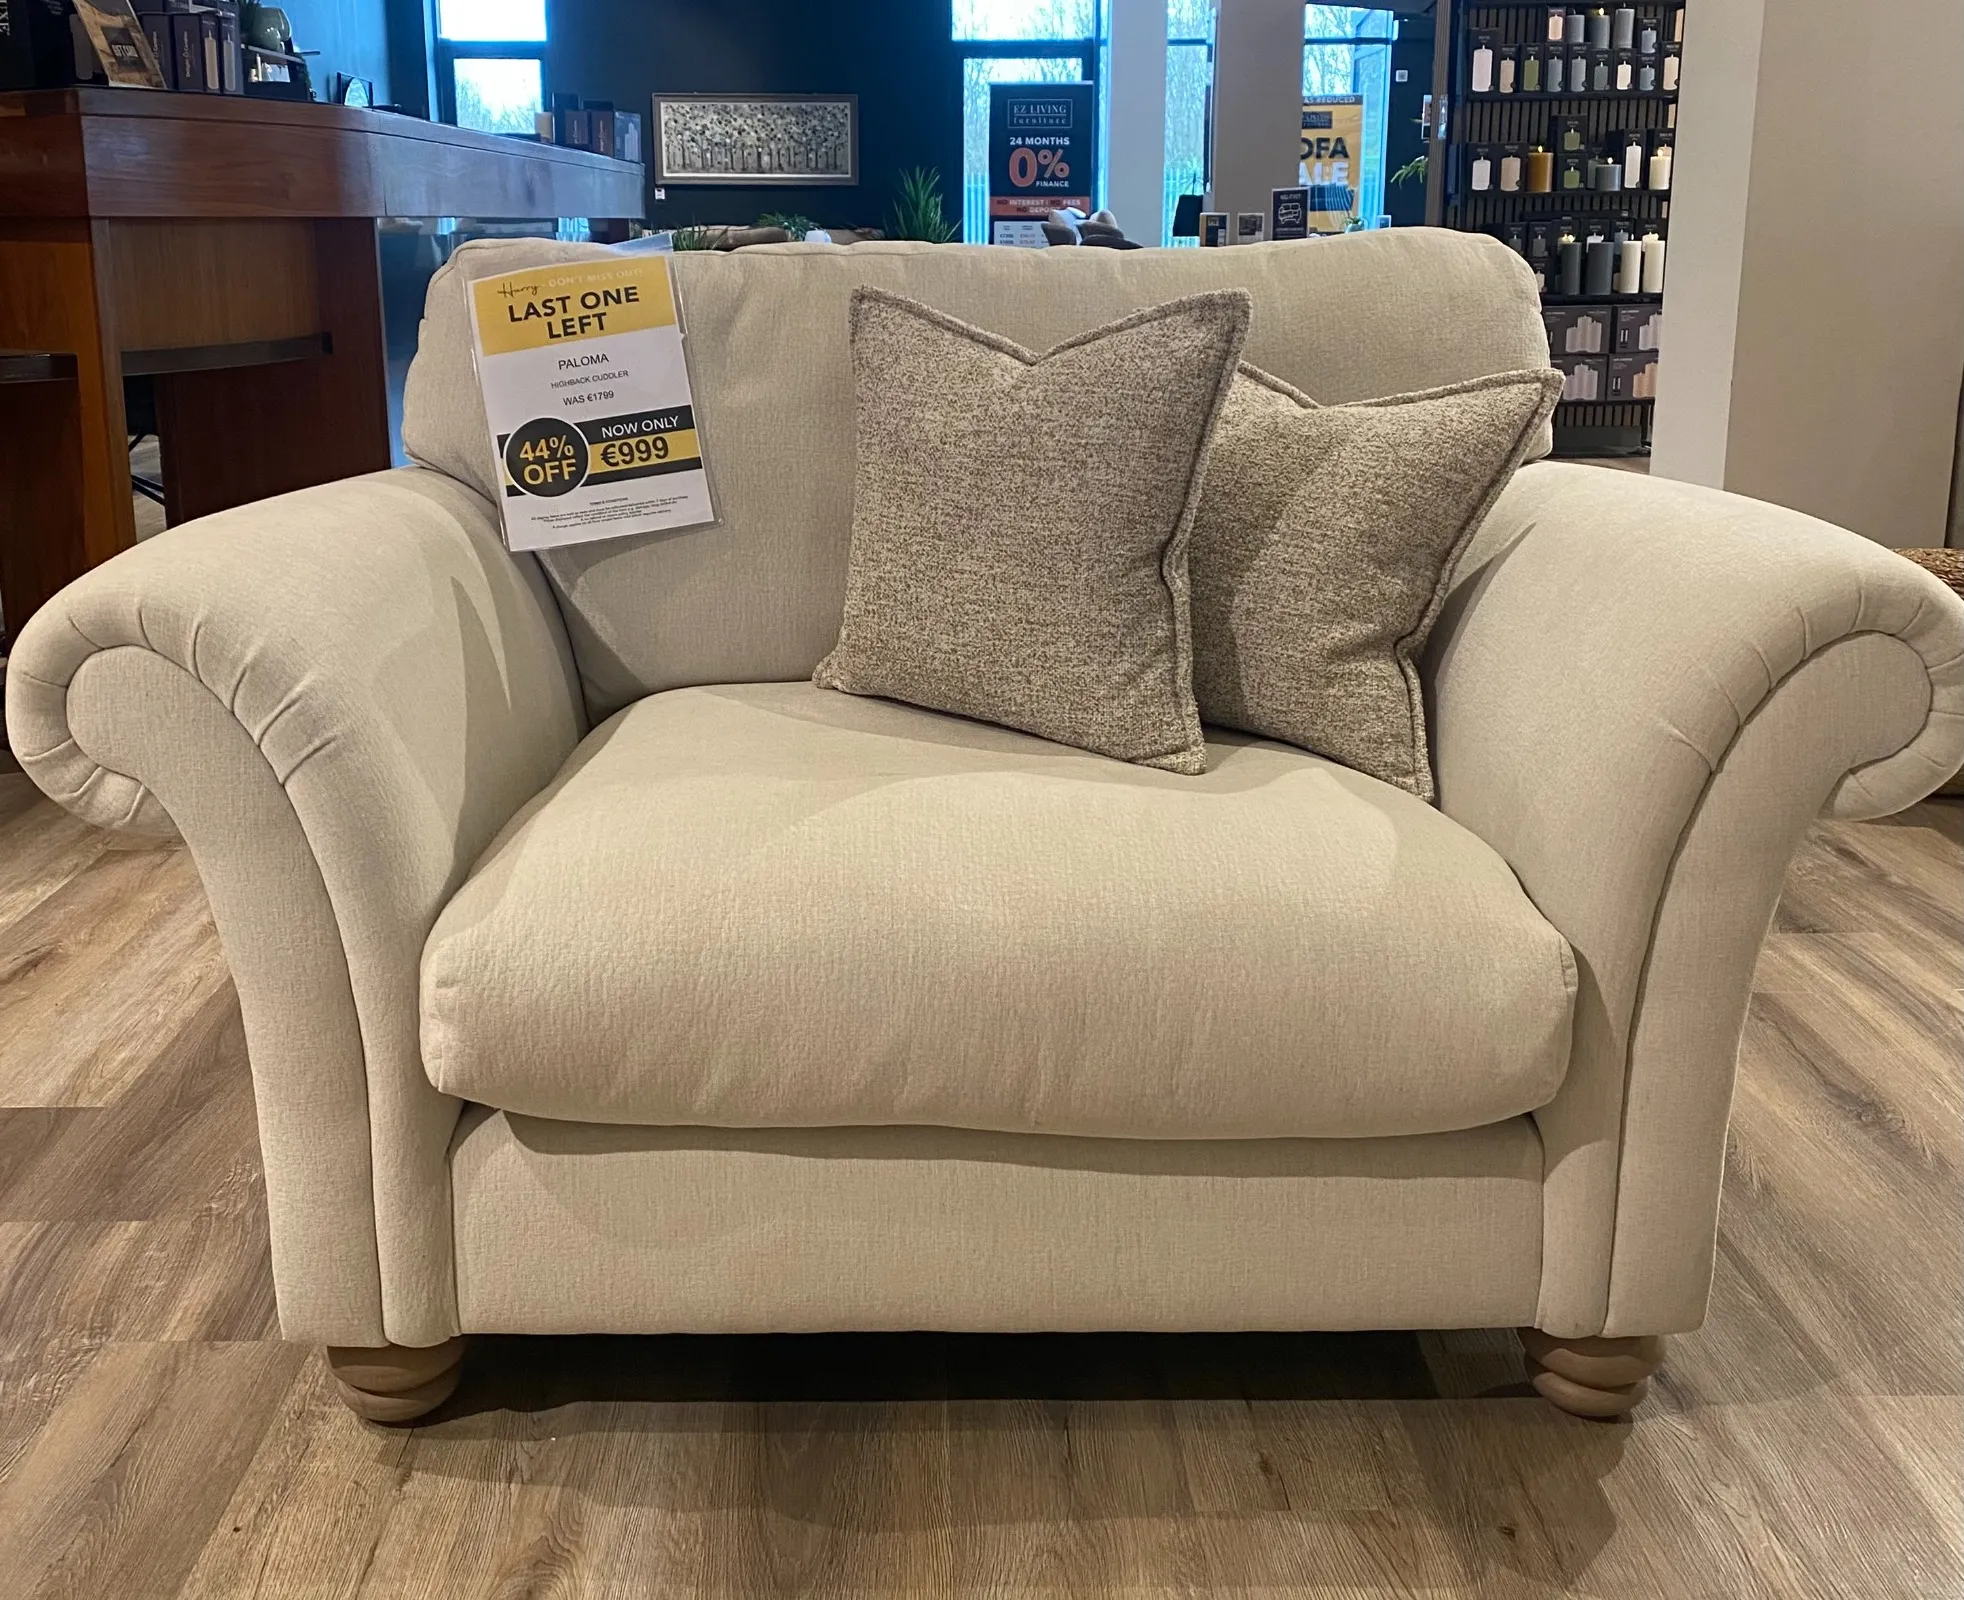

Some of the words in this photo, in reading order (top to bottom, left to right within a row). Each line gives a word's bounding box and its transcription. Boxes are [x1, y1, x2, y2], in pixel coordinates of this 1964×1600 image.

[1013, 104, 1026, 114] EZ
[1030, 104, 1067, 114] LIVING
[1013, 117, 1067, 125] furniture
[1009, 136, 1023, 145] 24
[1025, 136, 1070, 145] MONTHS
[1300, 137, 1349, 160] OFA
[1009, 147, 1070, 187] 0%
[1299, 161, 1349, 186] ALE
[548, 276, 583, 288] DON'T
[587, 272, 614, 282] MISS
[508, 296, 571, 323] LAST
[580, 286, 640, 310] ONE
[547, 312, 607, 339] LEFT
[558, 353, 610, 370] PALOMA
[550, 376, 591, 389] HIGHBACK
[592, 370, 629, 382] CUDDLER
[563, 395, 585, 406] WAS
[587, 390, 614, 402] €1799
[601, 422, 638, 438] NOW
[641, 415, 679, 432] ONLY
[519, 435, 574, 461] 44%
[600, 436, 669, 467] €999
[523, 459, 576, 485] OFF
